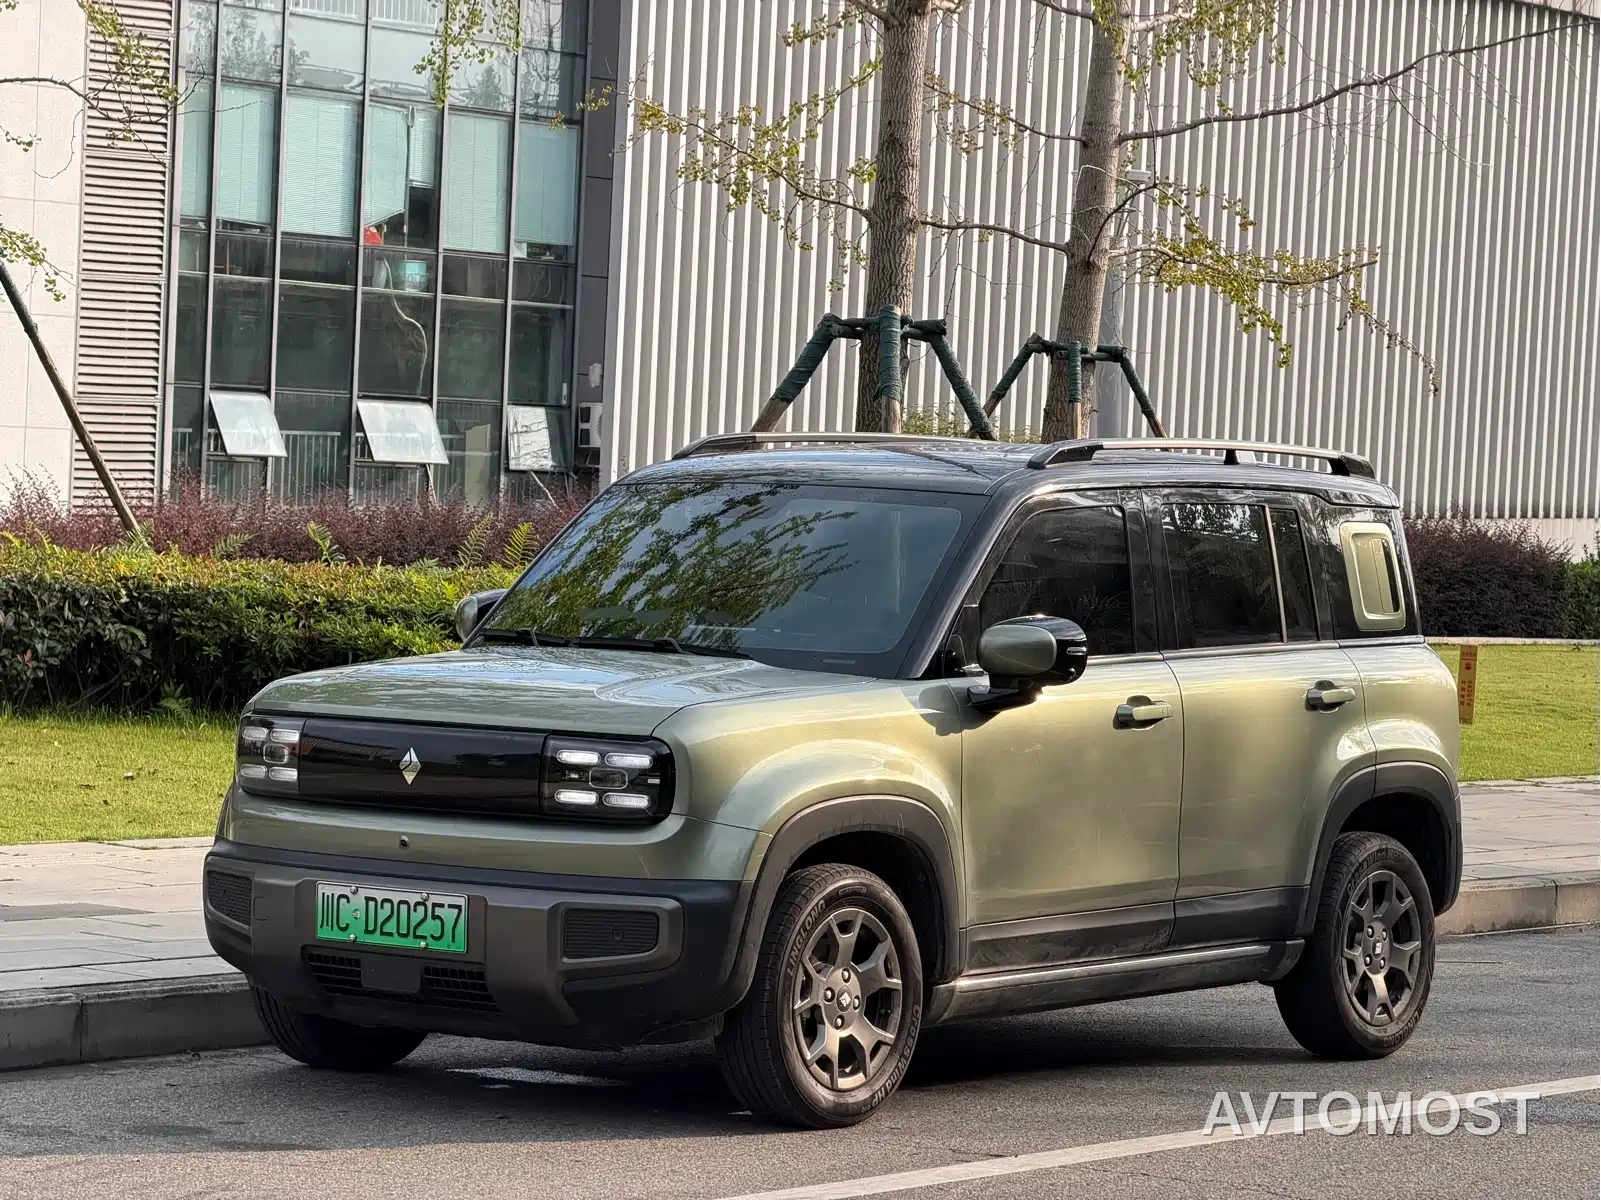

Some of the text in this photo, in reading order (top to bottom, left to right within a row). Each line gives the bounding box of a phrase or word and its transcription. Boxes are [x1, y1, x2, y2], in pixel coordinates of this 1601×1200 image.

[363, 895, 463, 943] D20257
[786, 899, 826, 977] LINGLONG
[1383, 1010, 1420, 1048] LINGLONG
